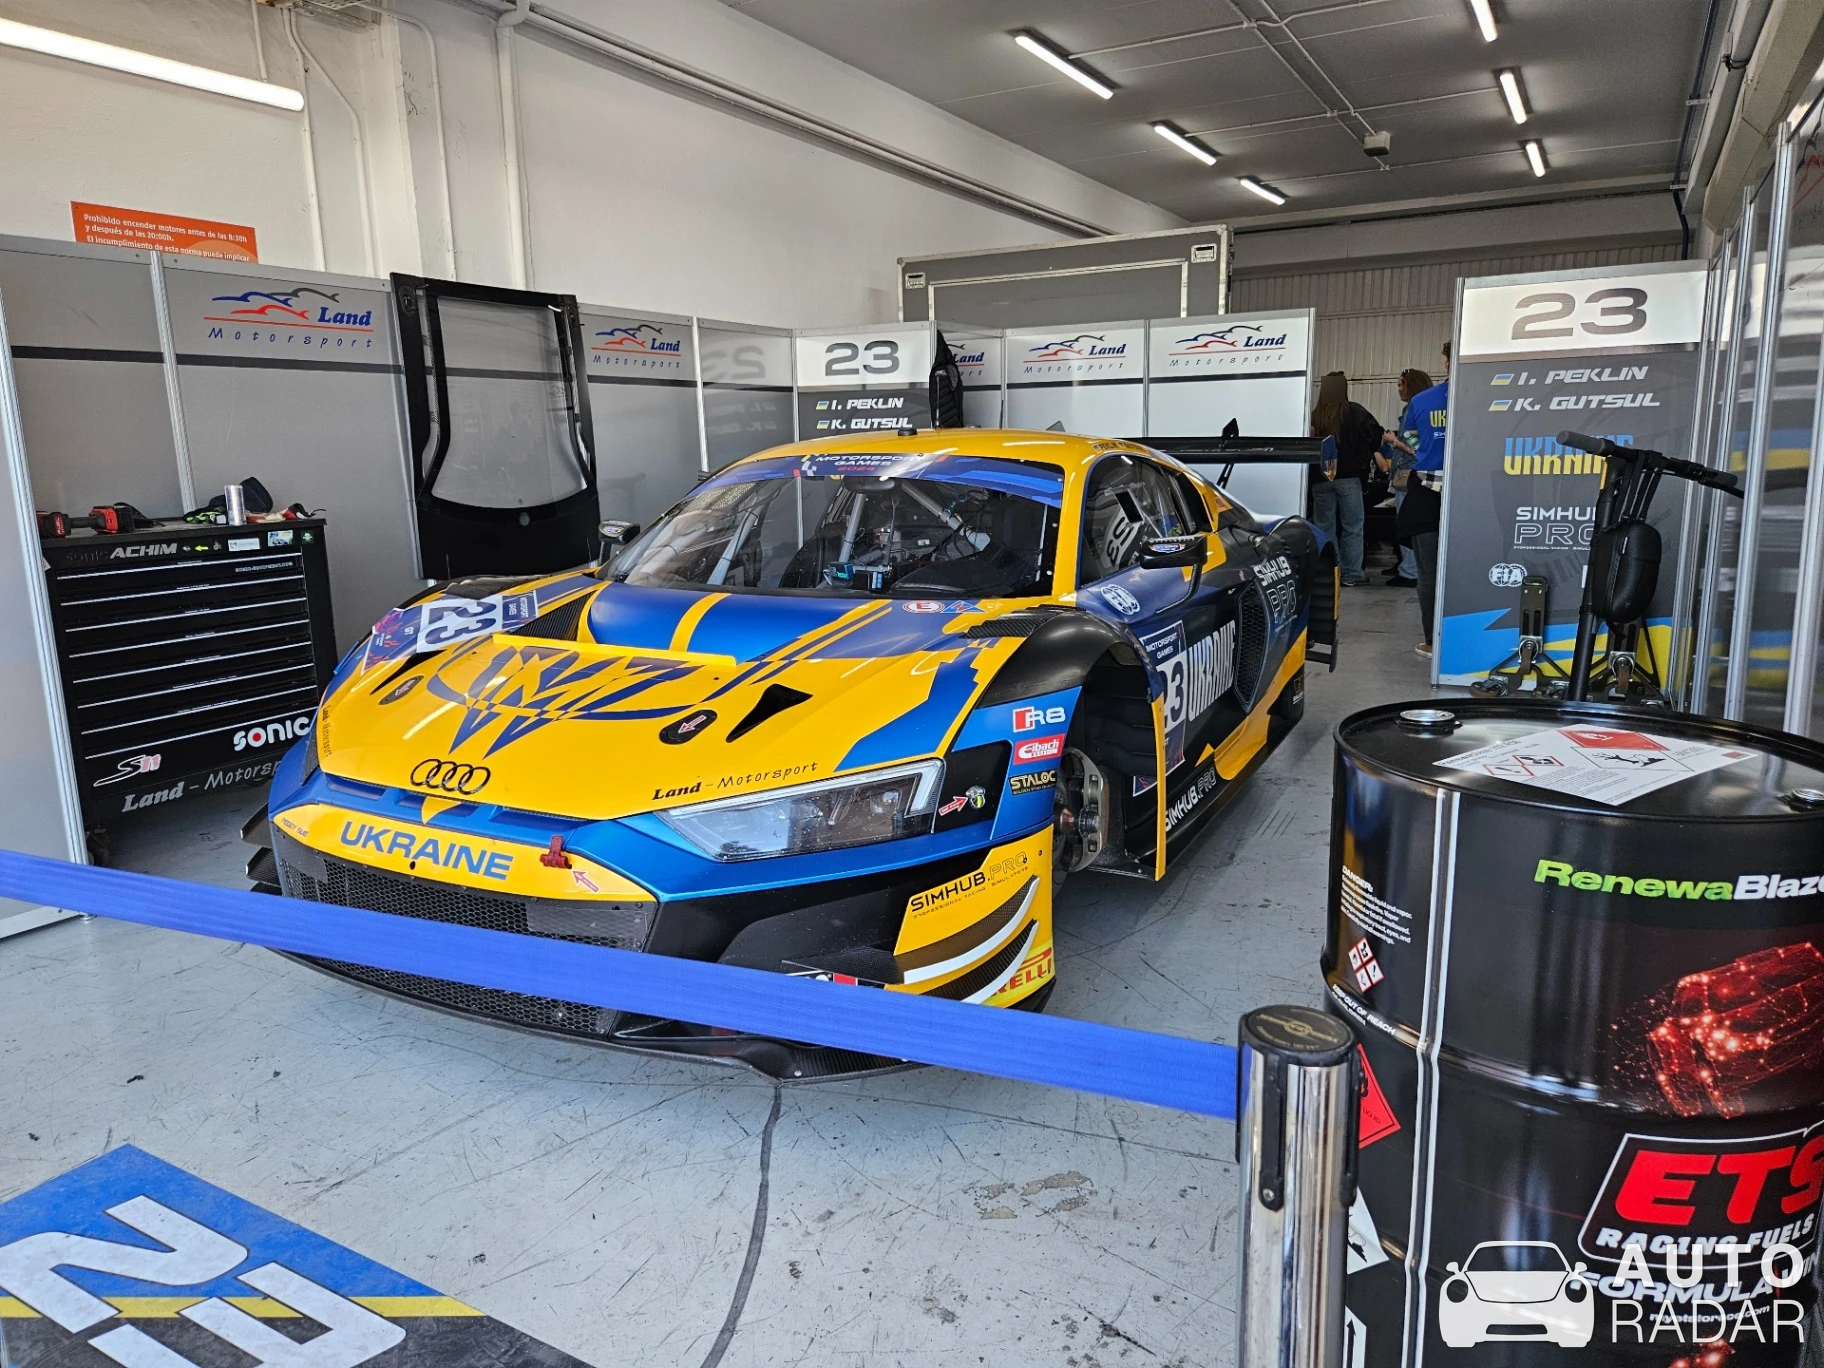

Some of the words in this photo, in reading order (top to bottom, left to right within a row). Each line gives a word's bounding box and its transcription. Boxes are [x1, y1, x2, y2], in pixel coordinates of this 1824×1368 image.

[84, 213, 121, 225] Prohibido
[123, 219, 156, 230] encender
[158, 223, 186, 234] motores
[188, 228, 206, 237] antes
[208, 230, 216, 239] de
[217, 232, 227, 240] las
[92, 224, 122, 236] después
[124, 229, 134, 237] de
[135, 230, 146, 238] las
[87, 235, 95, 243] El
[95, 236, 153, 250] incumplimiento
[155, 243, 164, 251] de
[165, 245, 179, 253] esta
[180, 247, 202, 256] norma
[203, 250, 223, 259] puede
[224, 251, 250, 262] implicar
[317, 306, 373, 326] Land
[1511, 288, 1648, 340] 23
[208, 327, 373, 349] Motorsport
[650, 337, 681, 352] Land
[1243, 333, 1287, 348] Land
[825, 340, 900, 376] 23
[953, 352, 985, 363] Land
[1088, 344, 1127, 356] Land
[593, 355, 680, 369] Motorsport
[1024, 363, 1124, 374] Motorsport
[1169, 354, 1283, 367] Motorsport
[1517, 372, 1537, 386] I.
[1545, 366, 1649, 384] PEKLIN
[831, 399, 842, 410] I.
[846, 397, 904, 410] PEKLIN
[1514, 398, 1540, 411] K.
[1549, 392, 1660, 410] GUTSUL
[830, 418, 847, 430] K.
[850, 417, 913, 429] GUTSUL
[1516, 506, 1596, 521] SIMHU
[110, 542, 178, 559] ACHIM
[425, 601, 497, 645] 23
[652, 781, 702, 801] Land
[717, 761, 819, 789] Motorsport
[1009, 769, 1057, 790] STALOC
[121, 781, 185, 812] Land
[340, 820, 515, 881] UKRAINE
[1344, 996, 1358, 1010] OUT
[1366, 1014, 1397, 1036] REACH
[1615, 1135, 1824, 1226] ETS
[1744, 1213, 1814, 1250] FUELS
